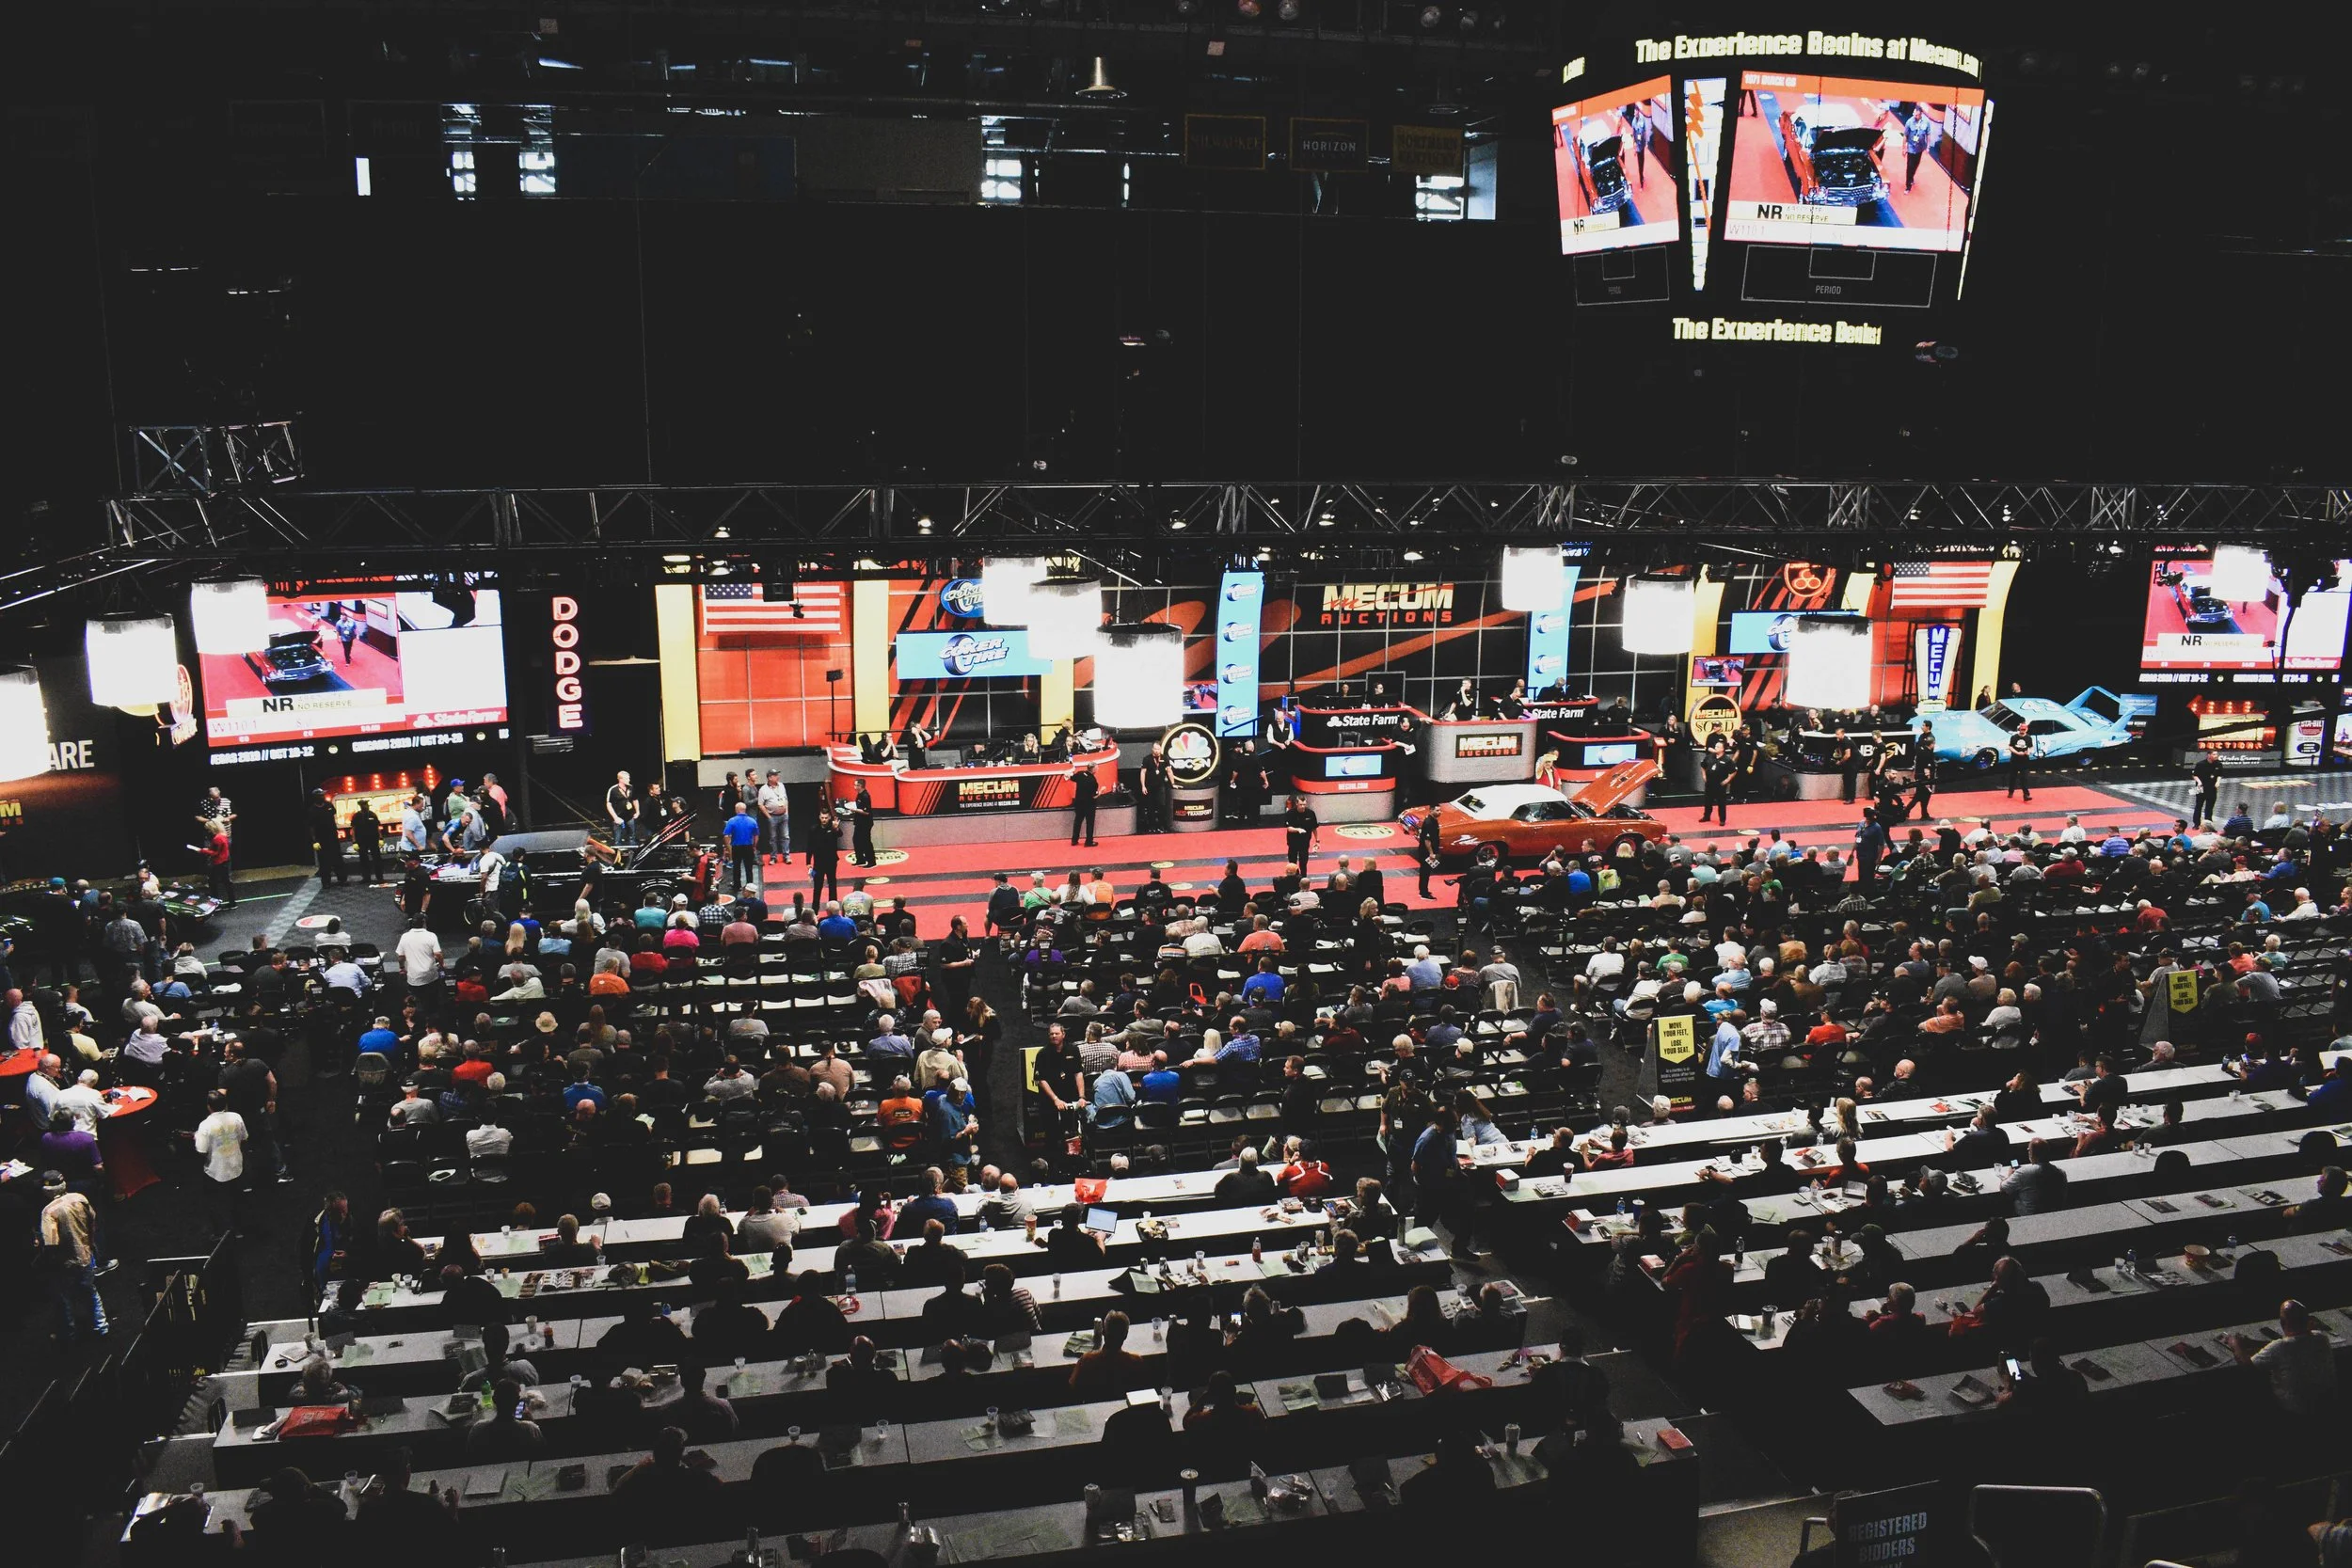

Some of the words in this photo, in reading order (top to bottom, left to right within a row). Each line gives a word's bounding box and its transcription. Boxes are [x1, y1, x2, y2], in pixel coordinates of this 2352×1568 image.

[1635, 39, 1672, 63] The
[1674, 31, 1803, 59] Experience
[1807, 31, 1883, 58] Begins
[1886, 38, 1908, 60] at
[1302, 139, 1357, 151] HORIZON
[1756, 204, 1783, 220] NR
[1815, 285, 1842, 295] PERIOD
[1673, 317, 1708, 340] The
[1711, 318, 1833, 342] Experience
[1322, 582, 1454, 611] MECUM
[1320, 610, 1454, 626] AUCTIONS
[2181, 635, 2202, 646] NR
[939, 638, 1005, 659] COKER
[552, 596, 583, 729] DODGE
[962, 646, 1009, 667] TIRE
[1929, 627, 1946, 697] MECUM
[262, 697, 294, 713] NR
[297, 703, 311, 711] NO
[312, 700, 353, 710] RESERVE
[2019, 700, 2058, 712] 43
[1342, 715, 1370, 726] State
[1372, 714, 1398, 725] Farm
[1531, 707, 1558, 720] State
[1559, 707, 1585, 719] Farm
[1695, 709, 1737, 720] MECUM
[1695, 721, 1734, 733] SOD
[1458, 736, 1518, 751] MECUM
[1458, 748, 1518, 757] AUCTIONS
[1168, 758, 1211, 771] NBCSN
[959, 780, 1020, 796] MECUM
[1338, 782, 1368, 790] MECUM.COM
[959, 793, 1020, 801] AUCTIONS
[1848, 1512, 1927, 1543] REGISTERED
[1859, 1536, 1916, 1565] BIDDERS
